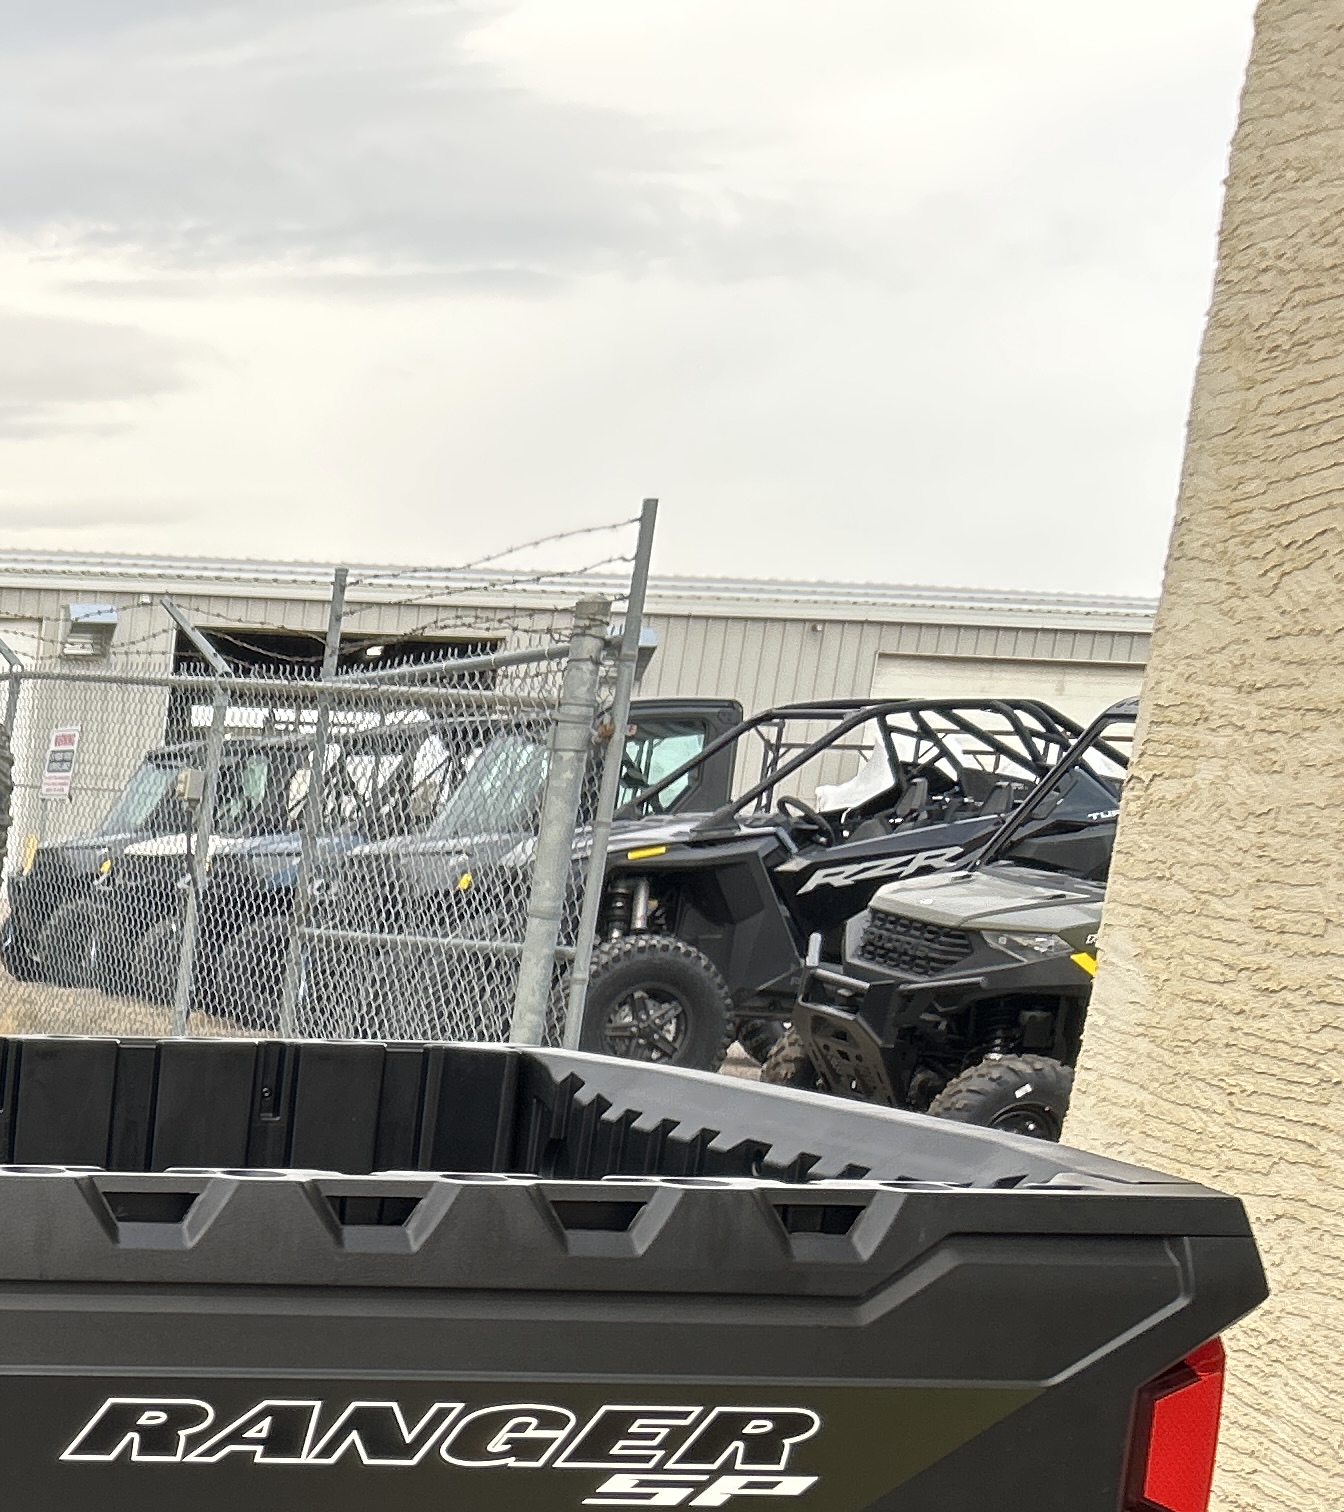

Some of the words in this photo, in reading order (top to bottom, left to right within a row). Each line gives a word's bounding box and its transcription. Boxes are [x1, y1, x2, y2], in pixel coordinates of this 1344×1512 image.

[796, 846, 964, 896] RZR
[59, 1396, 824, 1472] RANGER
[580, 1473, 819, 1507] SP
